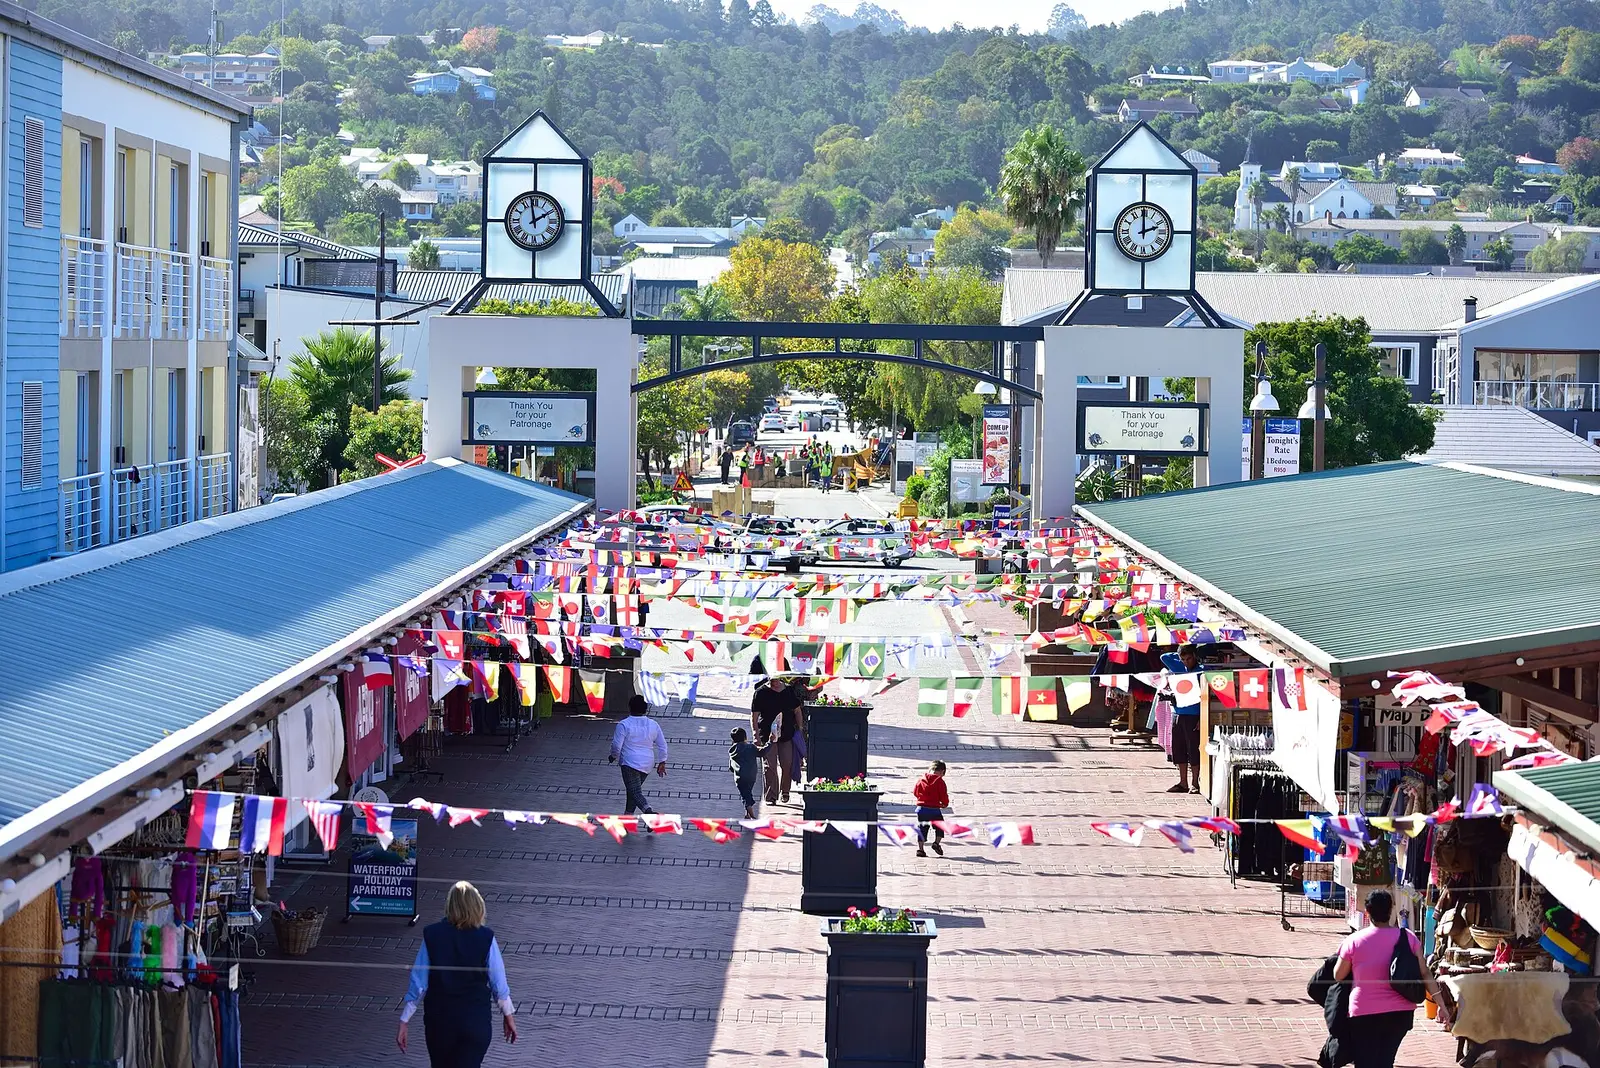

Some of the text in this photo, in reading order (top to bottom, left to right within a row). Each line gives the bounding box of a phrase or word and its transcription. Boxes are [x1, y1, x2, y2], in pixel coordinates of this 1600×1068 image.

[510, 402, 553, 410] Thank You
[528, 412, 547, 421] your
[1121, 411, 1146, 419] Thank
[510, 420, 552, 429] Patronage
[1127, 420, 1158, 429] for your
[1122, 429, 1164, 439] Patronage
[1266, 436, 1298, 445] Tonight's
[354, 865, 414, 876] WATERFRONT
[364, 875, 402, 885] HOLIDAY
[353, 885, 412, 896] APARTMENTS
